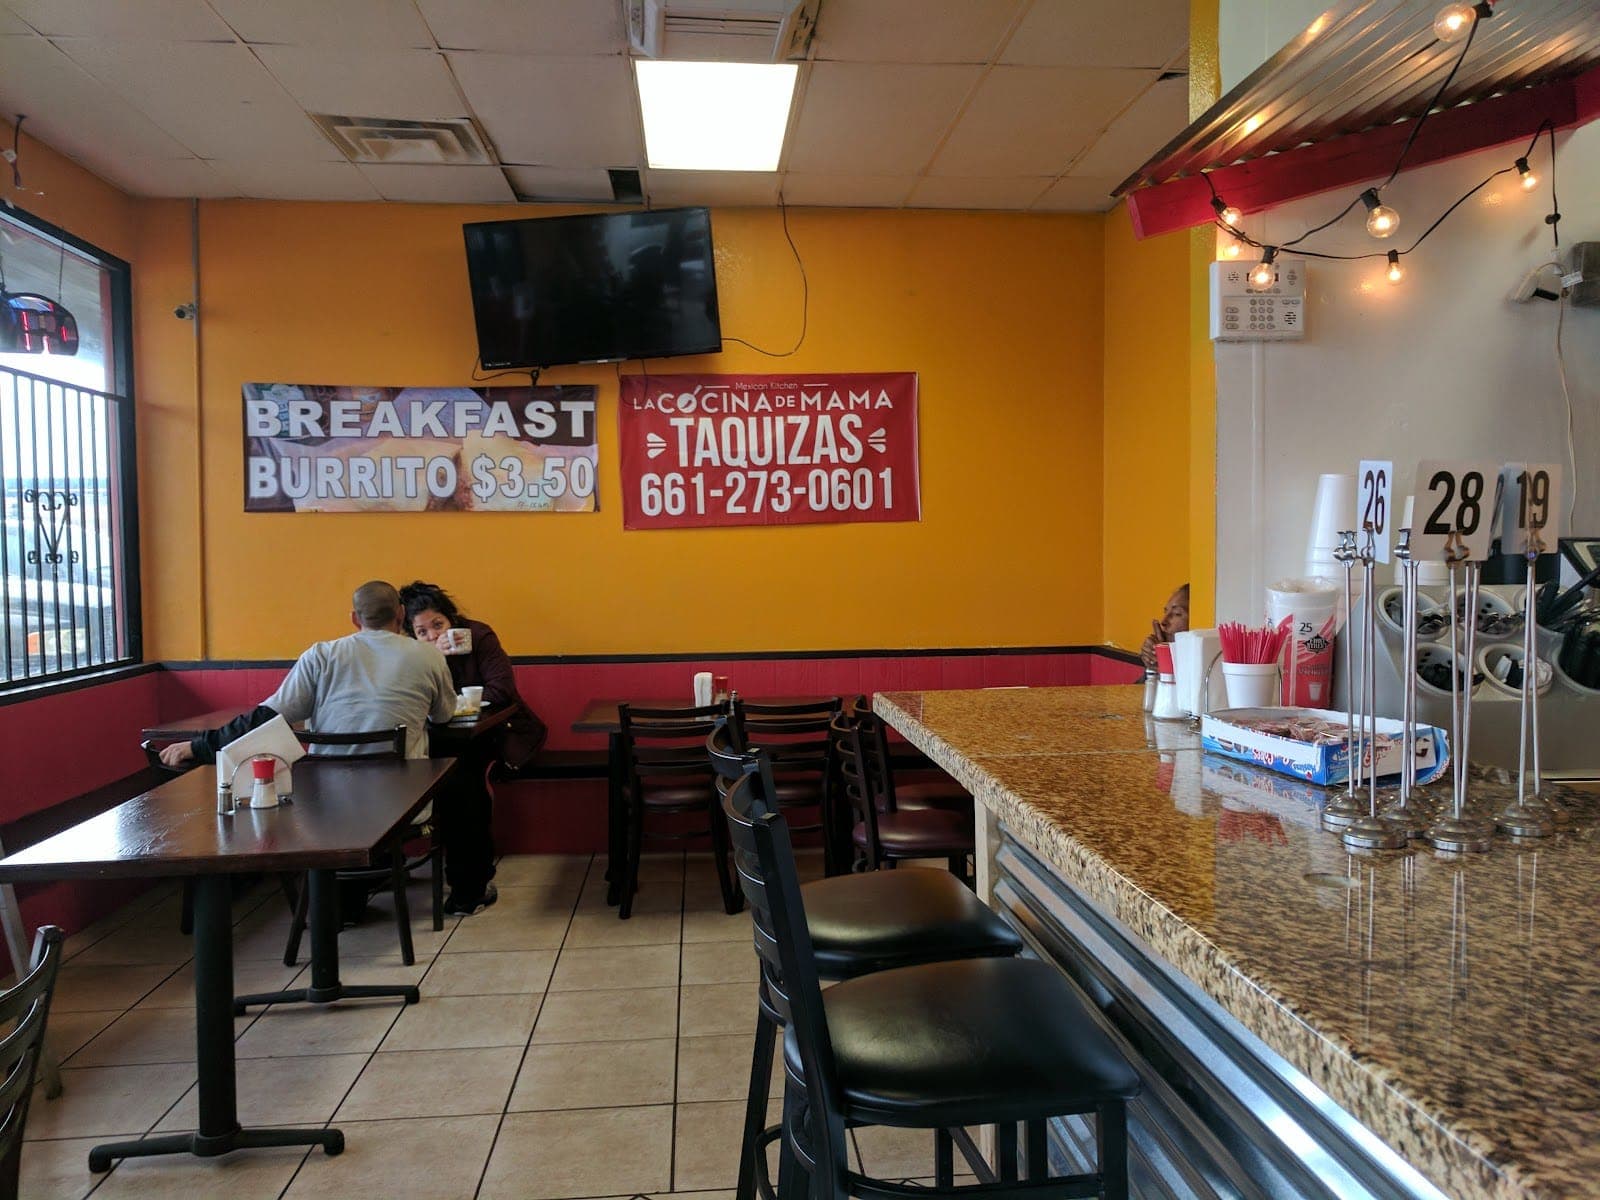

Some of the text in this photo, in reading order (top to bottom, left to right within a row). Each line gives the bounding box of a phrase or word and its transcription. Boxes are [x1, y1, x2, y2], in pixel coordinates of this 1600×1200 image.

[633, 385, 893, 414] LA COCINA DE MAMA
[735, 382, 798, 391] Mexican Kitchen
[246, 400, 595, 438] BREAKFAST
[669, 413, 864, 468] TAQUIZAS
[248, 453, 595, 503] BURRITO $3.50
[640, 467, 893, 516] 661-273-0601
[1362, 469, 1387, 535] 26
[1515, 469, 1550, 530] 19
[1422, 470, 1485, 536] 28
[1299, 622, 1314, 633] 25
